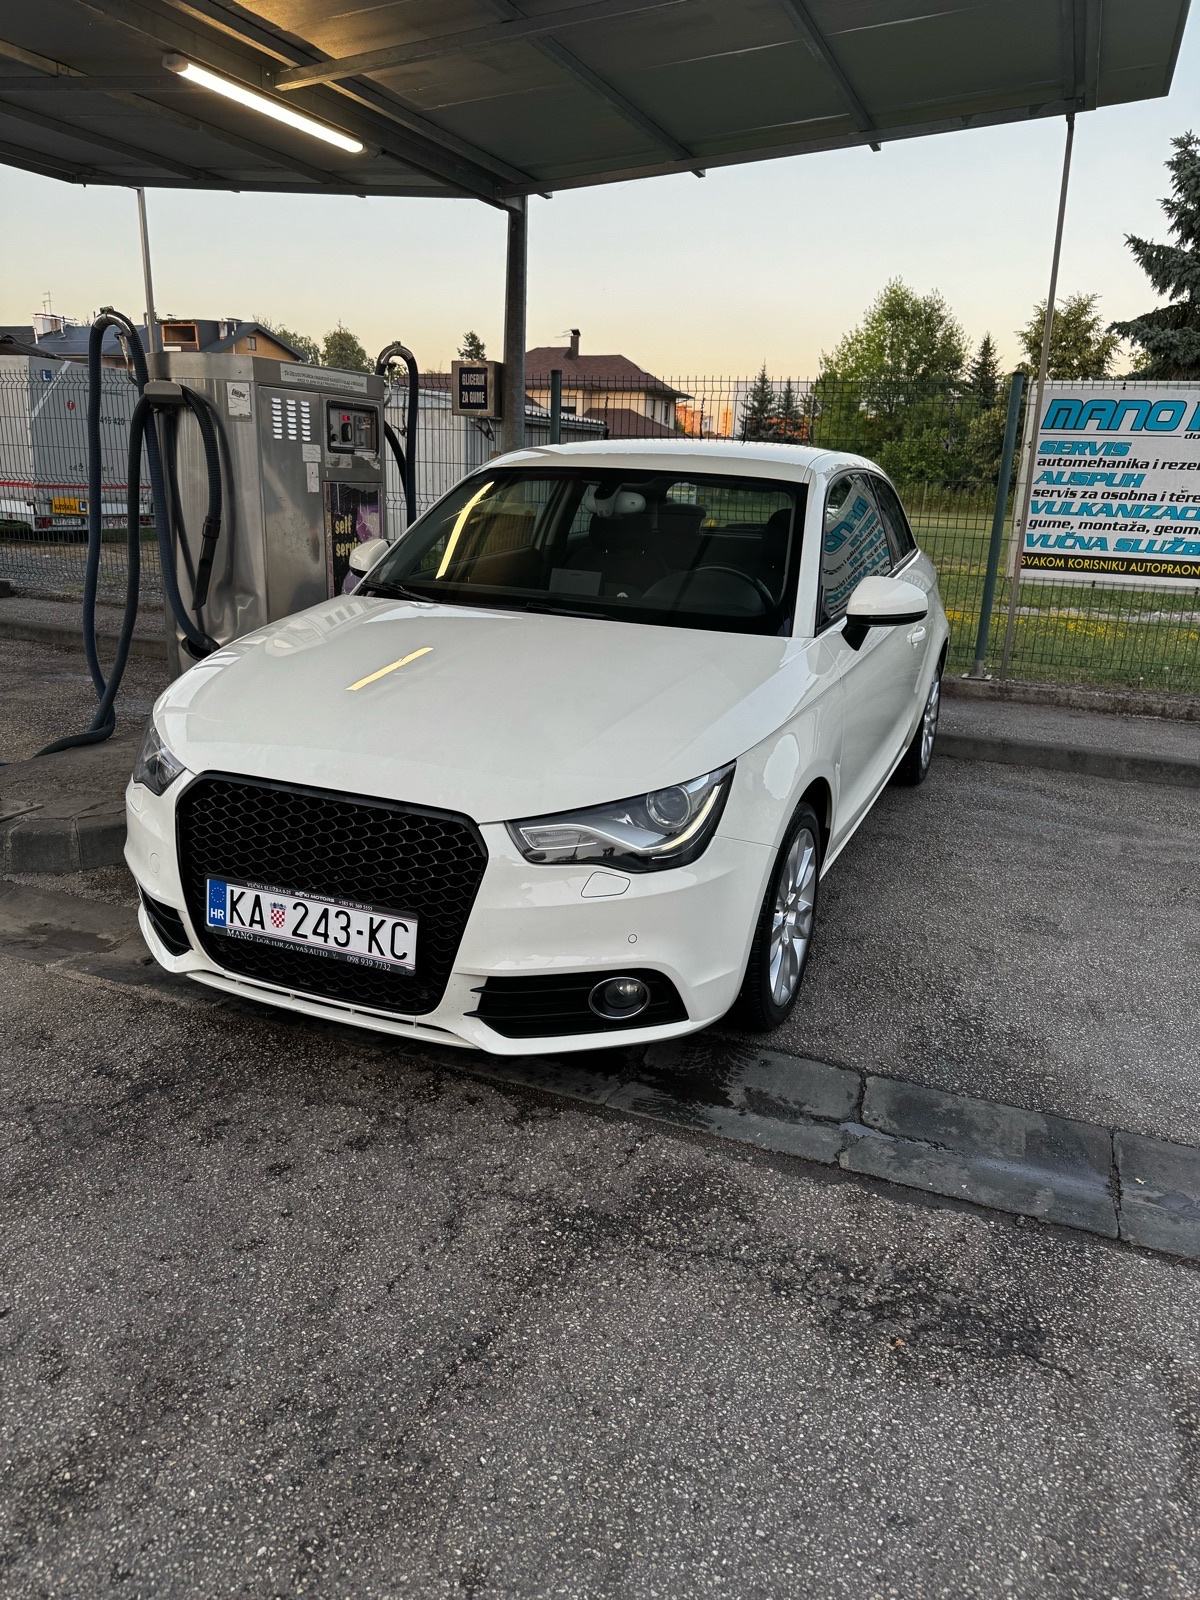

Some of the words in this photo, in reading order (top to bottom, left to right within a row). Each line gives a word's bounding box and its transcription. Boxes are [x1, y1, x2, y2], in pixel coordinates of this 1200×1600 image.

[462, 391, 469, 403] ZA
[470, 391, 485, 403] GUME
[1041, 399, 1187, 432] MANO
[1038, 440, 1132, 457] SERVIS
[1037, 457, 1150, 470] automehanika
[1152, 459, 1159, 469] i
[1033, 470, 1146, 488] AUSPUH
[1032, 487, 1077, 499] servis
[1080, 490, 1098, 499] za
[1101, 490, 1157, 502] osobna
[1160, 491, 1167, 502] i
[335, 514, 352, 535] self
[1028, 519, 1074, 531] gume,
[1078, 521, 1150, 535] montaža,
[1153, 524, 1200, 536] geom
[1026, 531, 1108, 551] VUČNA
[1020, 556, 1065, 568] SVAKOM
[1068, 558, 1126, 571] KORISNIKU
[1129, 562, 1200, 576] AUTOPRAON
[210, 908, 225, 920] HR
[230, 889, 265, 930] KA
[292, 902, 409, 960] 243-KC
[226, 929, 254, 941] MANO
[295, 943, 309, 953] VAŠ
[308, 947, 328, 958] AUTO
[346, 955, 360, 965] 098
[360, 958, 373, 968] 939
